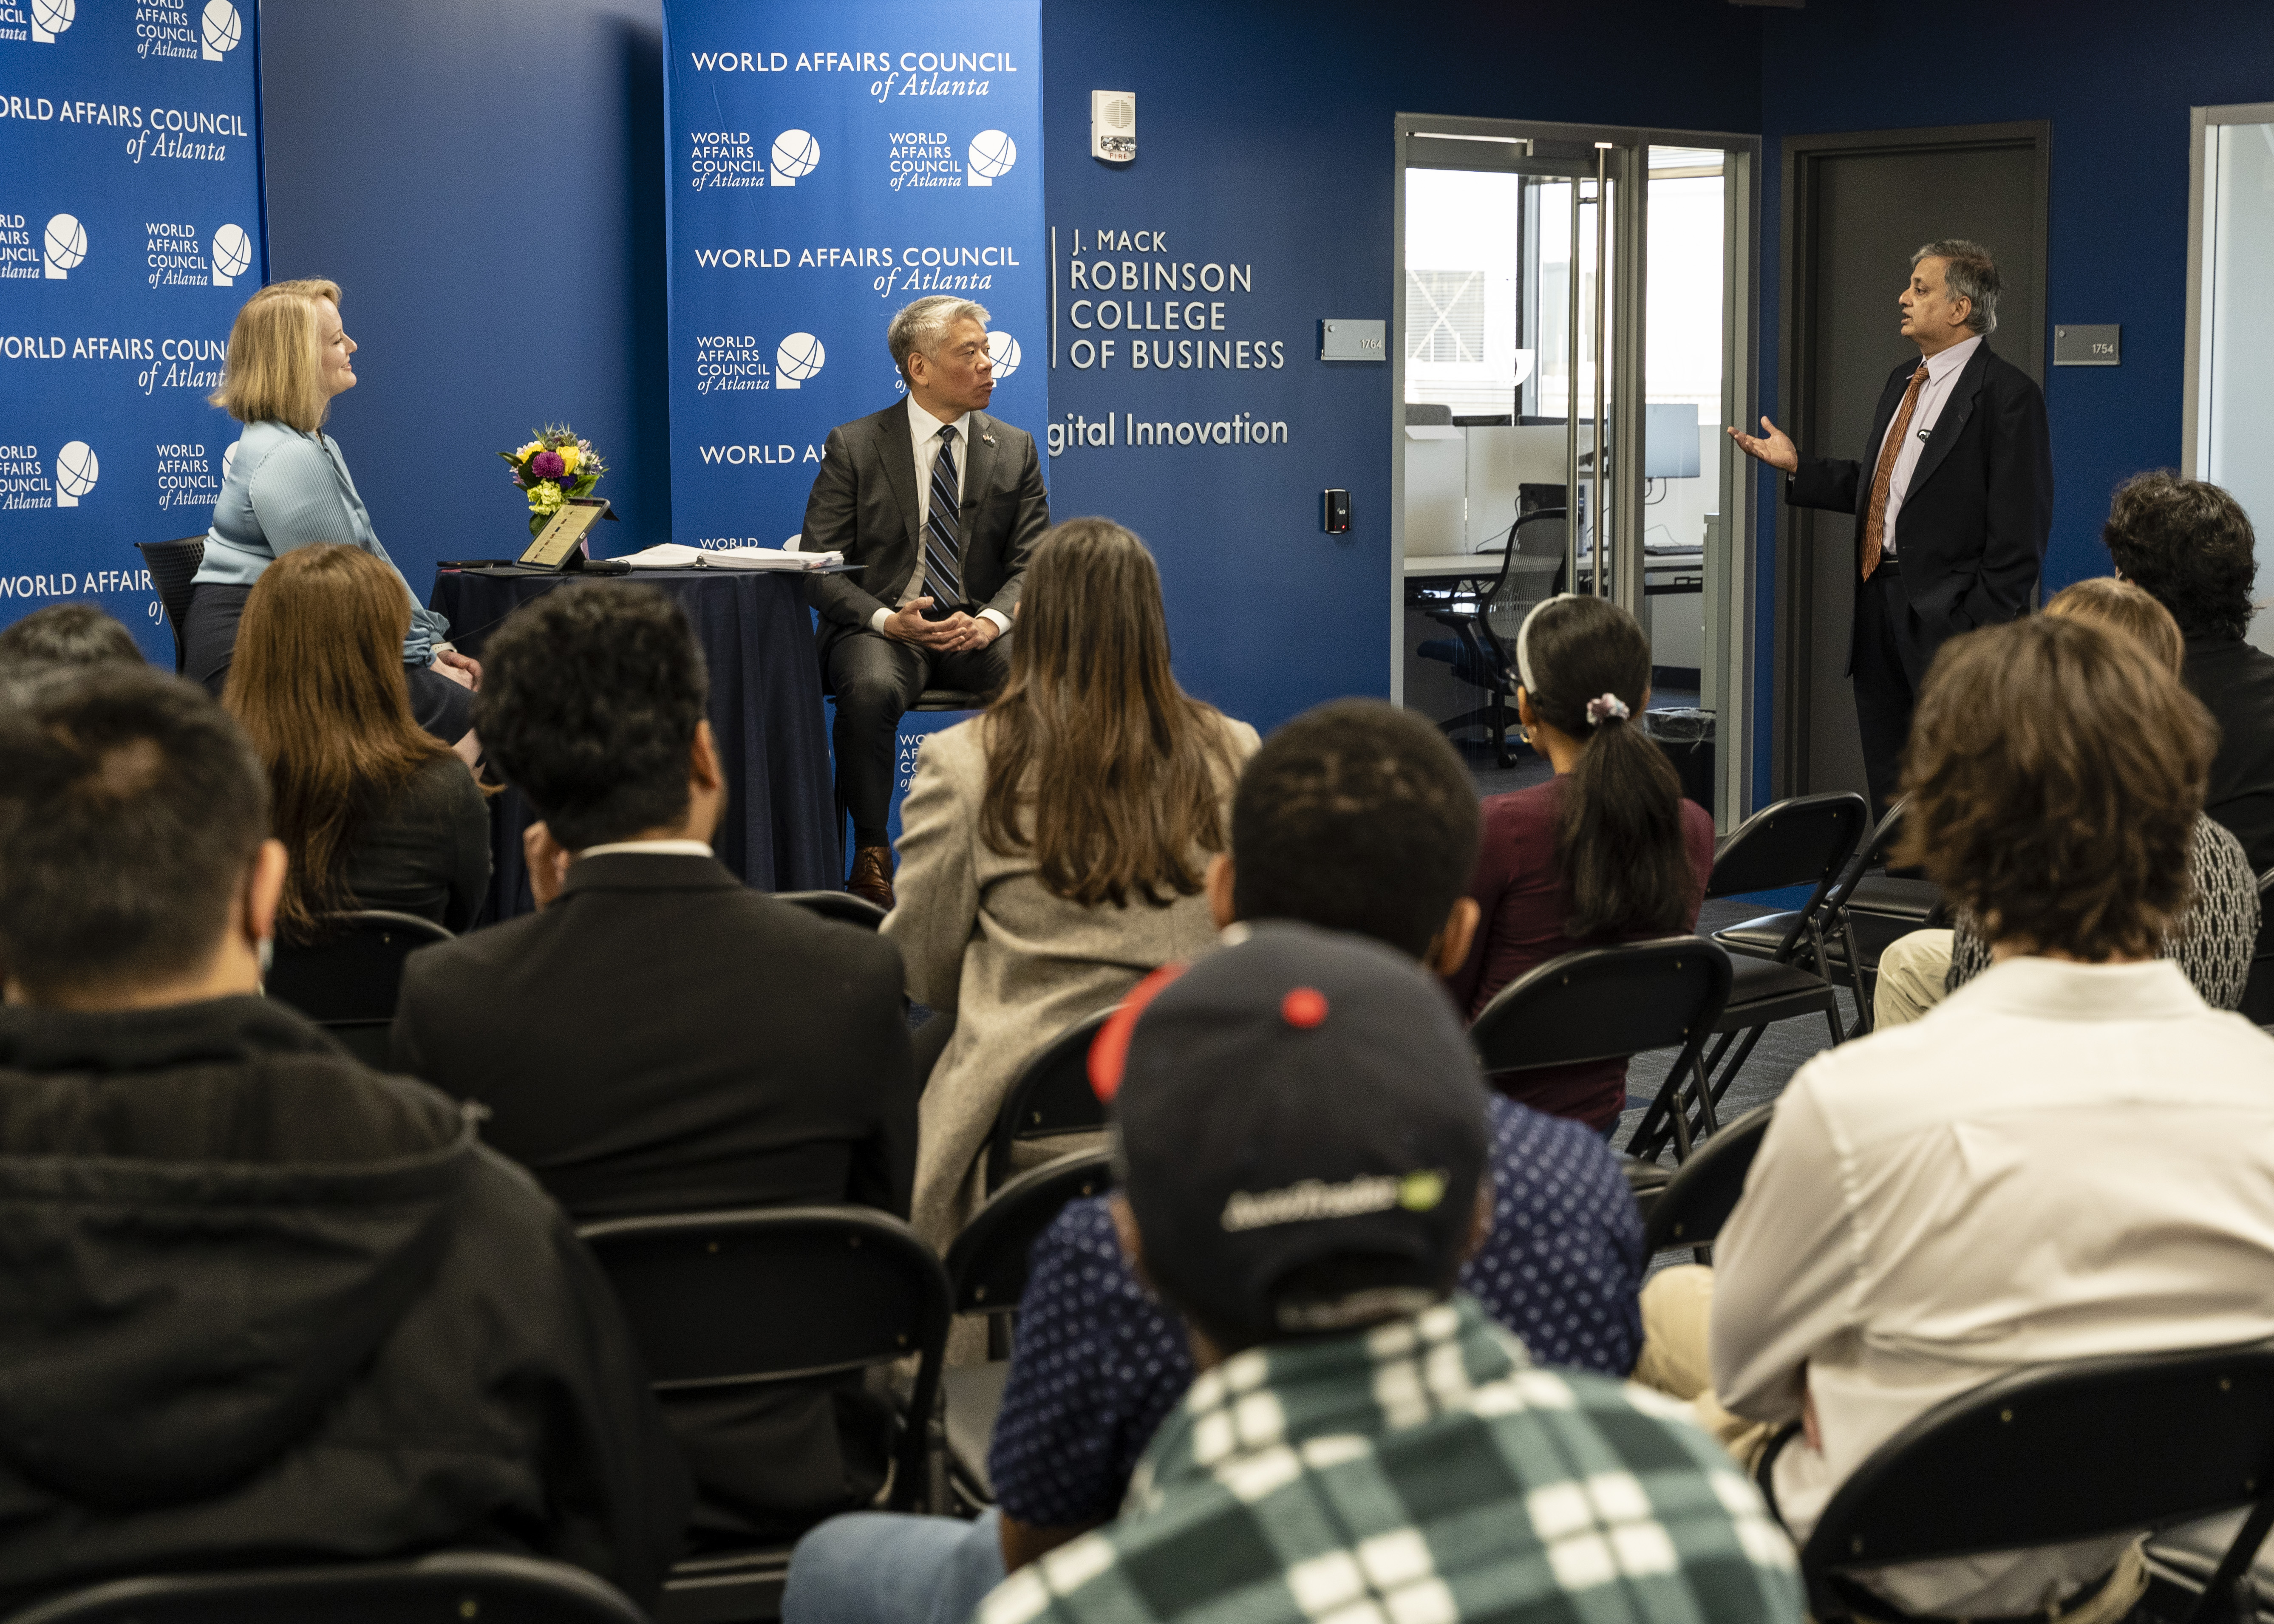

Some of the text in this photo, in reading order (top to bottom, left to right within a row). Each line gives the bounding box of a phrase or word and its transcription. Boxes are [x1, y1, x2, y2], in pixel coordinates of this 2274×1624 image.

[136, 8, 188, 26] AFFAIRS
[136, 24, 197, 43] COUNCIL
[137, 38, 197, 59] of Atlanta
[692, 52, 1017, 72] WORLD AFFAIRS COUNCIL
[870, 73, 989, 103] of Atlanta
[60, 101, 142, 128] AFFAIRS
[150, 108, 247, 136] COUNCIL
[127, 130, 226, 164] of Atlanta
[691, 132, 750, 144] WORLD
[889, 133, 947, 144] WORLD
[691, 147, 754, 158] AFFAIRS
[889, 147, 951, 158] AFFAIRS
[692, 161, 765, 172] COUNCIL
[890, 160, 962, 172] COUNCIL
[692, 173, 764, 191] of Atlanta
[890, 173, 961, 192] of Atlanta
[146, 223, 195, 237] WORLD
[147, 238, 198, 253] AFFAIRS
[1072, 229, 1167, 256] J. MACK
[148, 254, 208, 269] COUNCIL
[695, 247, 1019, 269] WORLD AFFAIRS COUNCIL
[149, 268, 208, 289] of Atlanta
[874, 267, 992, 298] of Atlanta
[1071, 260, 1251, 292] ROBINSON
[1070, 300, 1226, 331] COLLEGE
[0, 336, 229, 361] ORLD AFFAIRS COUN
[697, 336, 755, 348] WORLD
[1360, 339, 1382, 349] 1764
[2092, 343, 2114, 354] 1754
[697, 350, 759, 362] AFFAIRS
[1070, 340, 1284, 369] OF BUSINESS
[139, 361, 161, 396] of
[698, 364, 770, 376] COUNCIL
[698, 376, 770, 395] of Atlanta
[1126, 412, 1288, 445] Innovation
[156, 444, 204, 457] WORLD
[699, 445, 795, 464] WORLD
[158, 460, 208, 473] AFFAIRS
[159, 475, 218, 489] COUNCIL
[2, 492, 52, 510] Atlanta
[159, 489, 218, 511] of Atlanta
